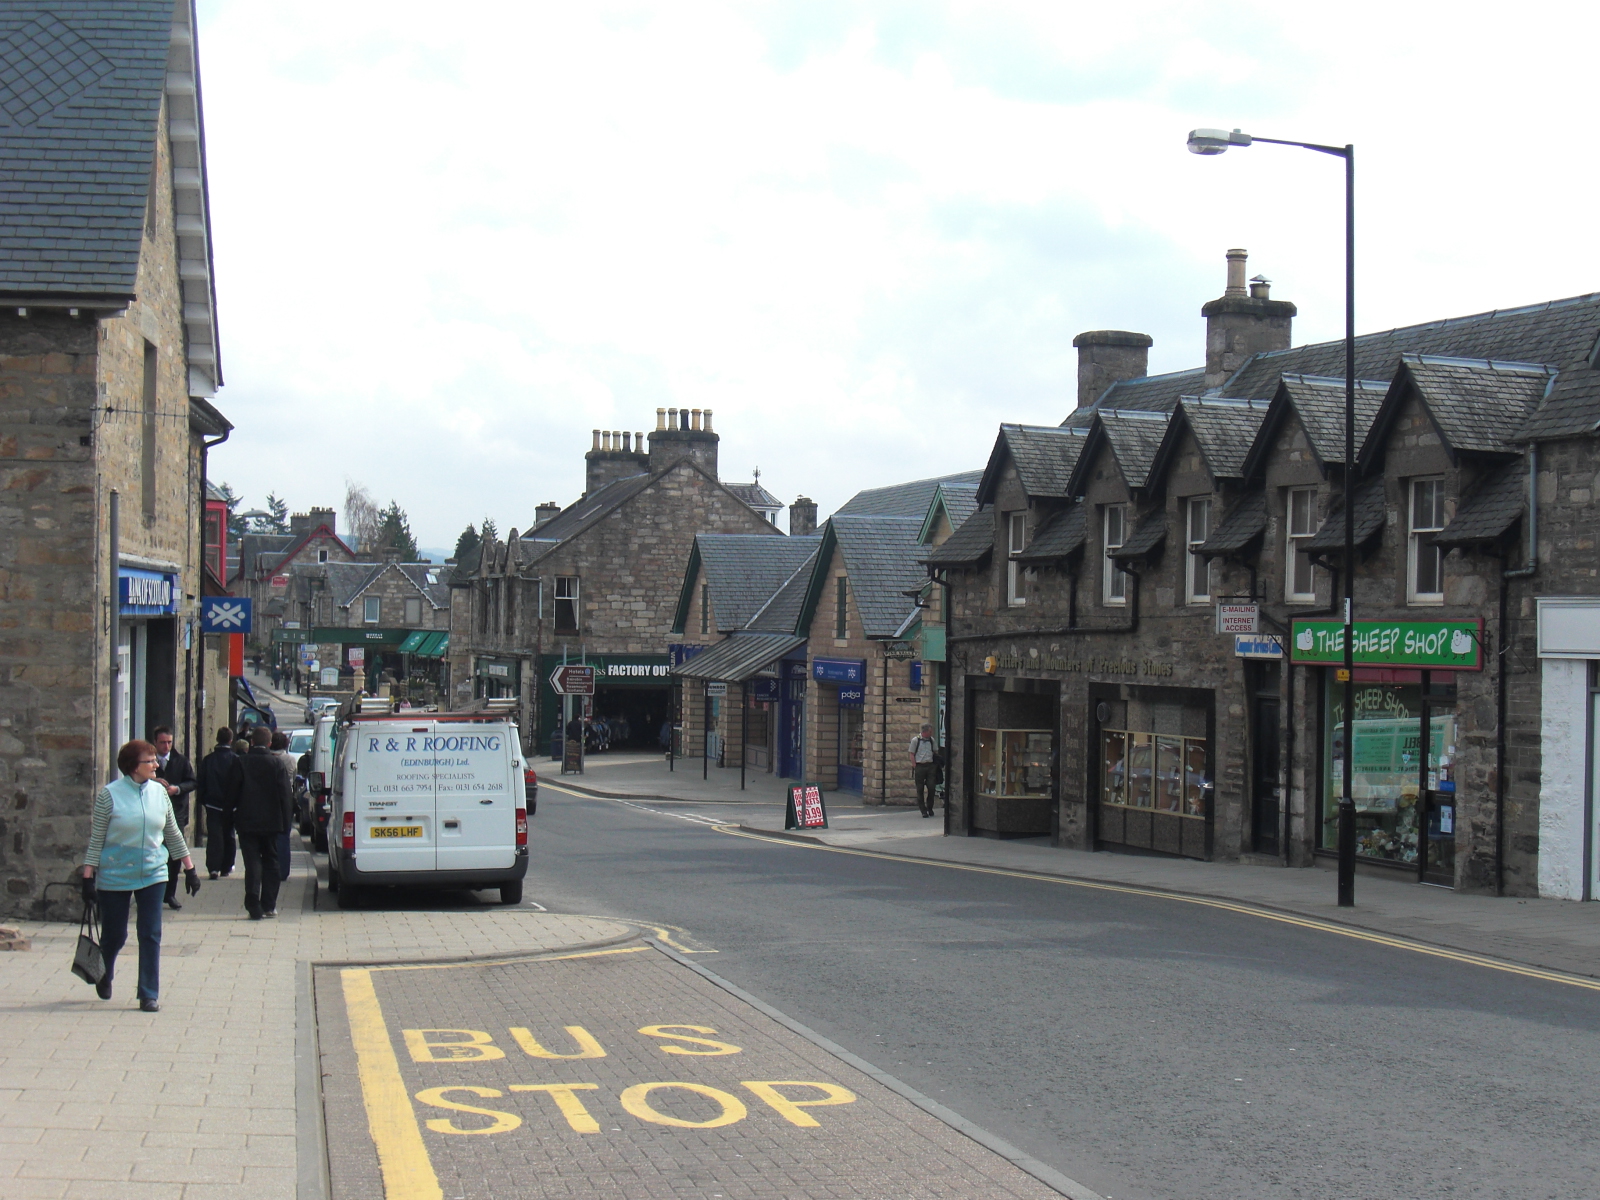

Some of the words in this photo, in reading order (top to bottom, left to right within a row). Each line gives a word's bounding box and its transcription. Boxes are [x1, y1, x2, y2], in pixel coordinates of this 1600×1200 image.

[128, 577, 141, 604] BANK
[141, 578, 148, 605] OF
[148, 579, 170, 606] SCOTLAND
[1316, 629, 1345, 653] THE
[1351, 628, 1399, 654] SHEEP
[1404, 628, 1448, 655] SHOP
[608, 665, 651, 676] FACTORY
[1026, 656, 1041, 669] and
[1043, 655, 1081, 672] Mounters
[1086, 657, 1094, 672] of
[1099, 656, 1137, 675] Precious
[1142, 658, 1173, 677] Stones
[841, 690, 861, 700] pdsa
[1354, 688, 1383, 711] SHEEP
[368, 737, 380, 752] R
[385, 737, 399, 752] &
[405, 737, 417, 752] R
[422, 736, 501, 752] ROOFING
[400, 758, 455, 767] (EDINBURGH)
[456, 758, 470, 766] Ltd.
[396, 773, 430, 781] ROOFING
[367, 785, 381, 793] Tel.
[415, 784, 432, 792] 7954
[487, 783, 503, 791] 2618
[374, 829, 399, 838] SK56
[401, 828, 419, 837] LHF
[401, 1024, 743, 1062] BUS
[414, 1080, 858, 1135] STOP
